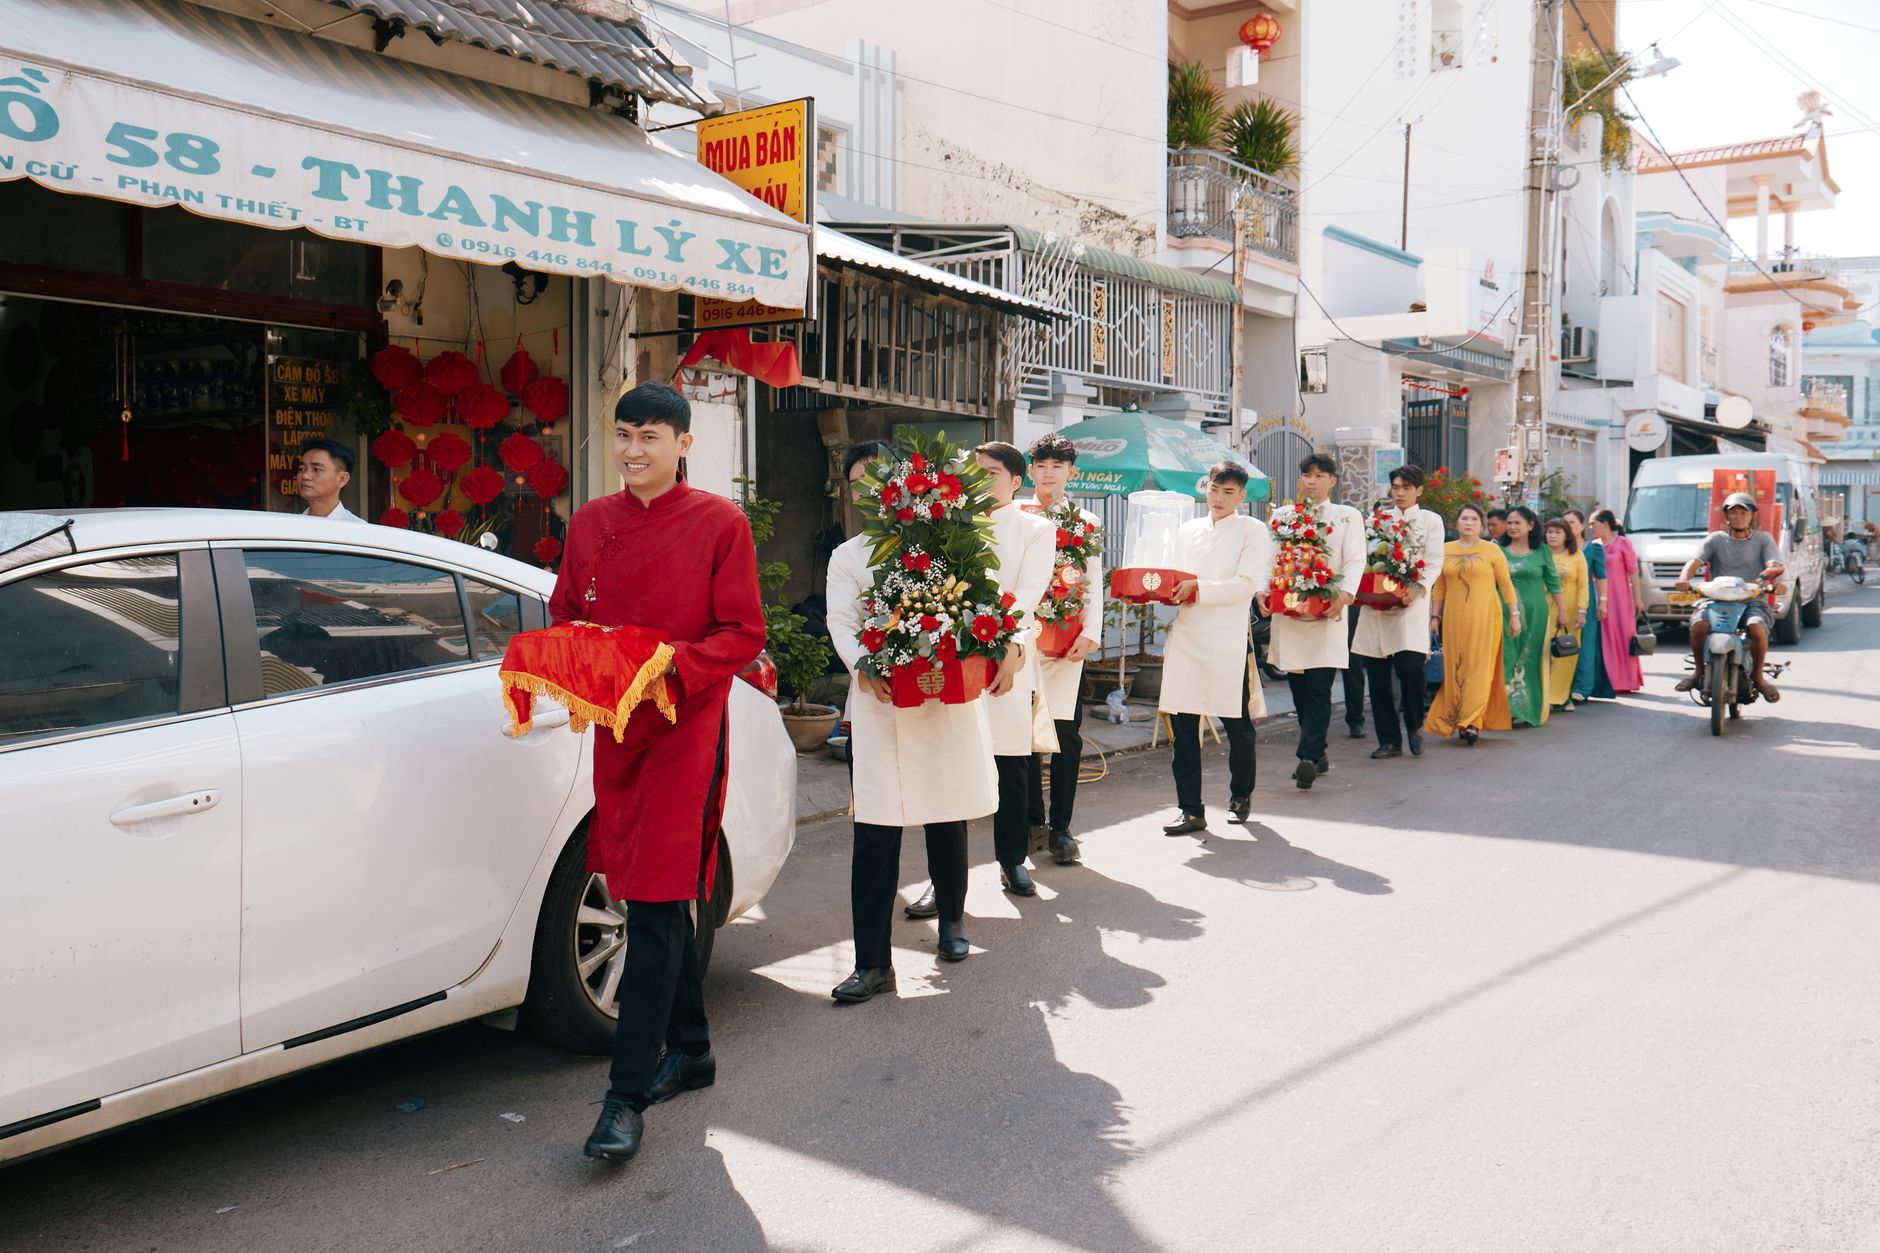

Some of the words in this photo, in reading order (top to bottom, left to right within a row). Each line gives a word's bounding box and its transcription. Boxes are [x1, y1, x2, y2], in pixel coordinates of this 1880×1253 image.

[705, 135, 751, 174] MUA
[756, 121, 796, 167] BÁN
[25, 160, 79, 181] CỪ
[118, 175, 205, 206] PHAN
[215, 193, 303, 222] THIẾT
[334, 215, 369, 232] BT
[105, 122, 221, 177] 58
[301, 155, 596, 248] THANH
[616, 219, 697, 263] LÝ
[715, 239, 789, 281] XE
[460, 238, 517, 259] 0916
[525, 249, 568, 266] 446
[576, 256, 613, 273] 844
[633, 266, 679, 284] 0914
[684, 274, 721, 290] 446
[726, 281, 756, 296] 844
[702, 307, 733, 322] 0916
[736, 304, 765, 318] 446
[284, 385, 298, 402] XE
[301, 384, 326, 404] MÁY
[269, 450, 294, 470] MÁY
[1087, 470, 1124, 484] NGÀY
